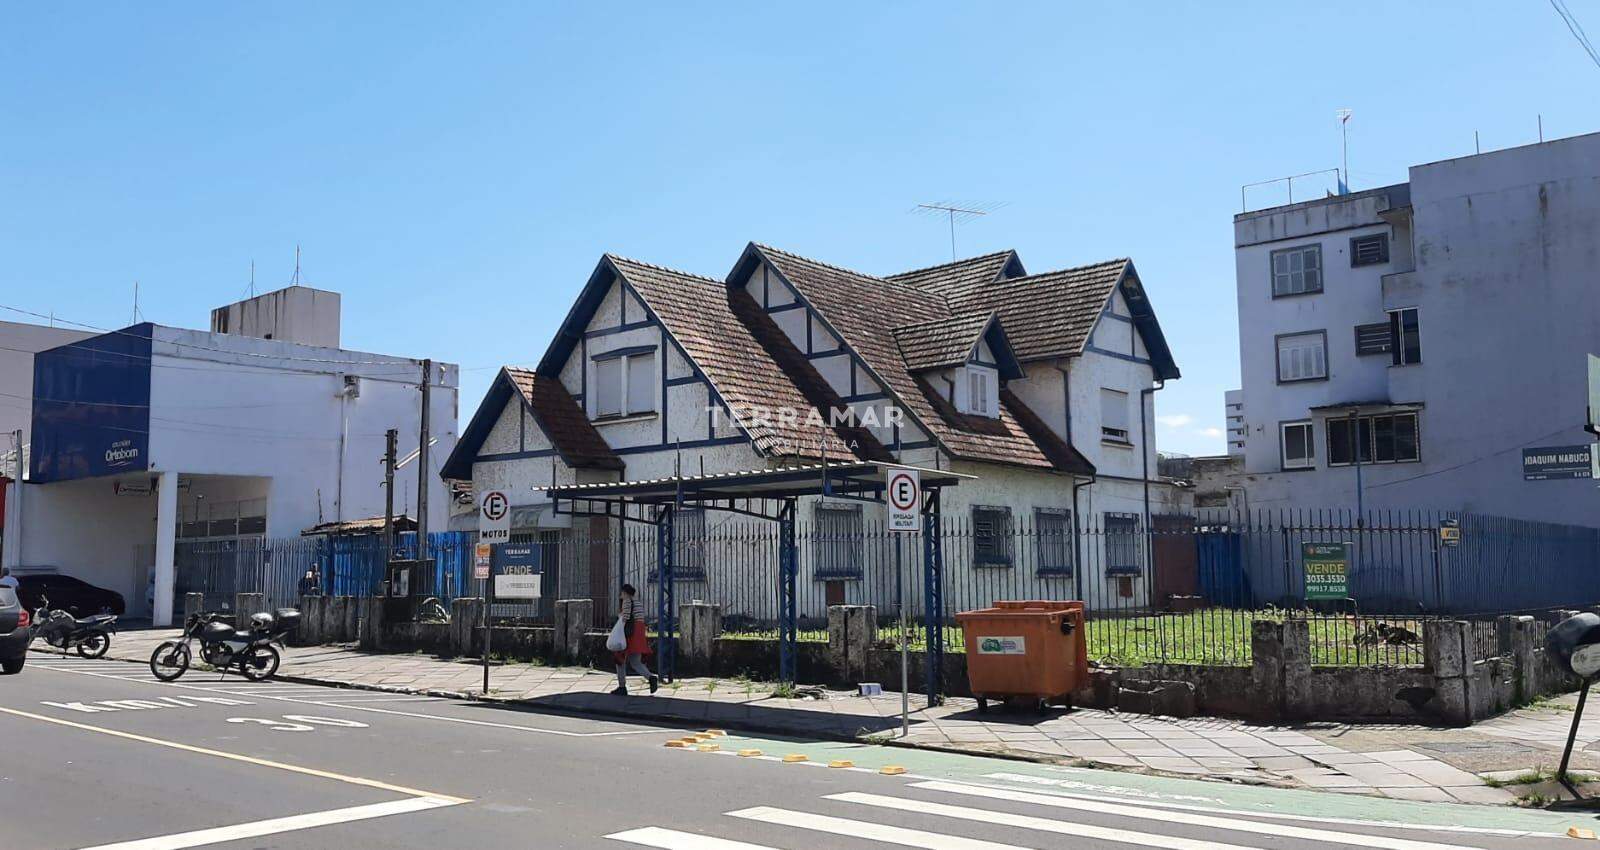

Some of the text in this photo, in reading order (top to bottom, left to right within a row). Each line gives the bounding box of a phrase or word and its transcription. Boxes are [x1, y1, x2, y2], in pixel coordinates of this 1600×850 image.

[105, 448, 138, 461] Ortobom
[1525, 452, 1590, 465] JOAQUIM NABUCO
[899, 482, 909, 502] E
[490, 496, 501, 515] E
[481, 530, 508, 539] MOTOS
[502, 565, 533, 576] VENDE
[1306, 563, 1345, 574] VENDE
[1306, 574, 1346, 583] 3035.3530
[226, 715, 370, 731] 30
